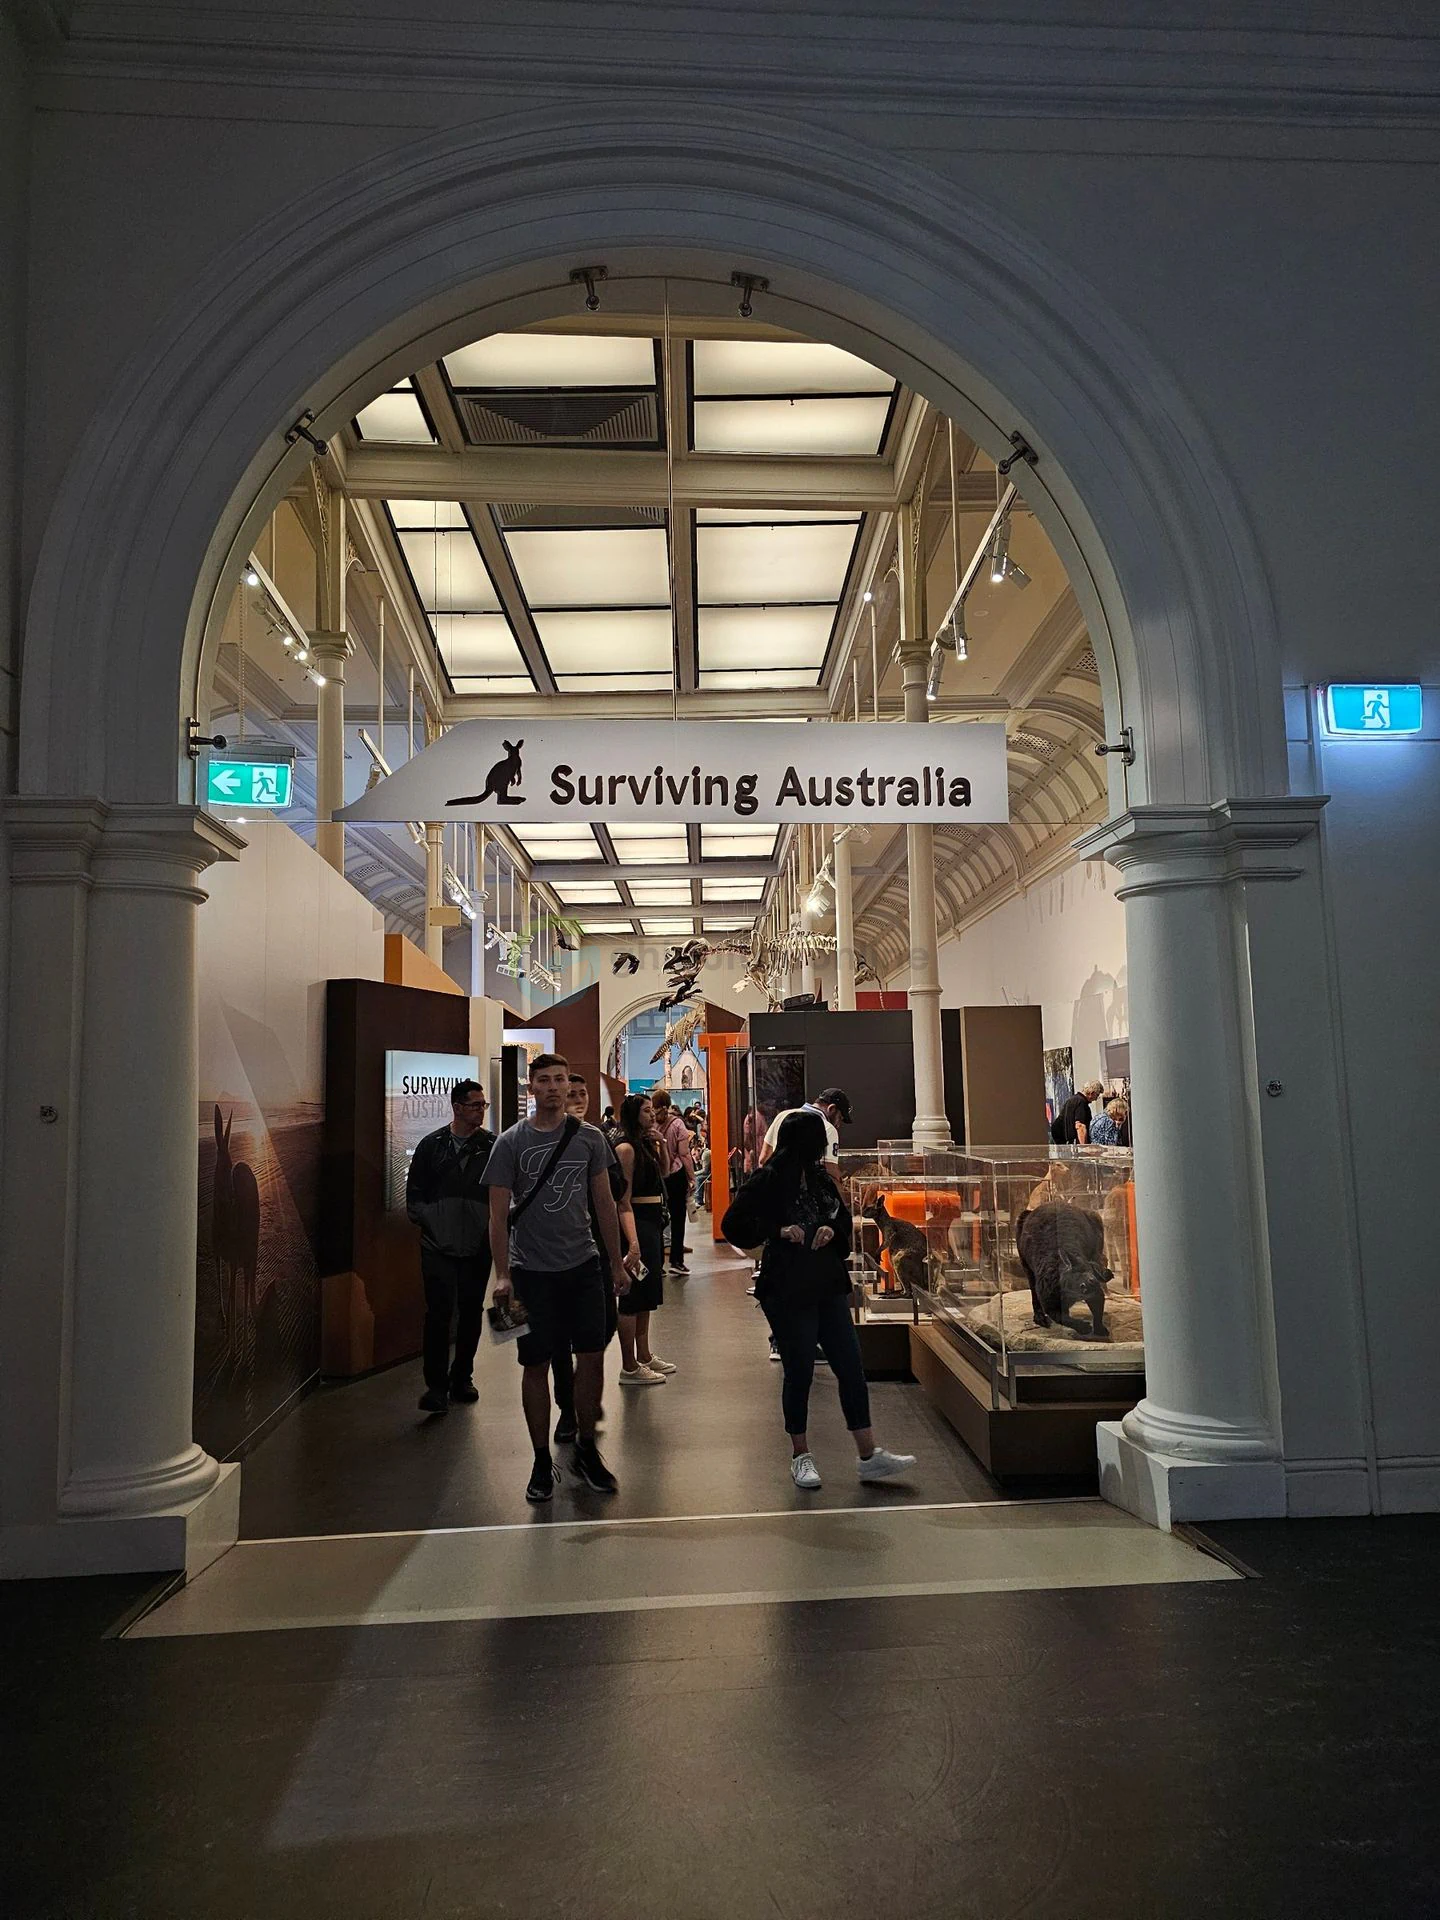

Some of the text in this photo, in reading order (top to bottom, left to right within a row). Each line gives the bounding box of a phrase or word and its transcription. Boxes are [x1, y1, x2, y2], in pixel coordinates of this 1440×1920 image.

[550, 764, 972, 815] Surviving Australia
[403, 1075, 471, 1095] SURVIVI
[401, 1100, 453, 1120] AUSTRA
